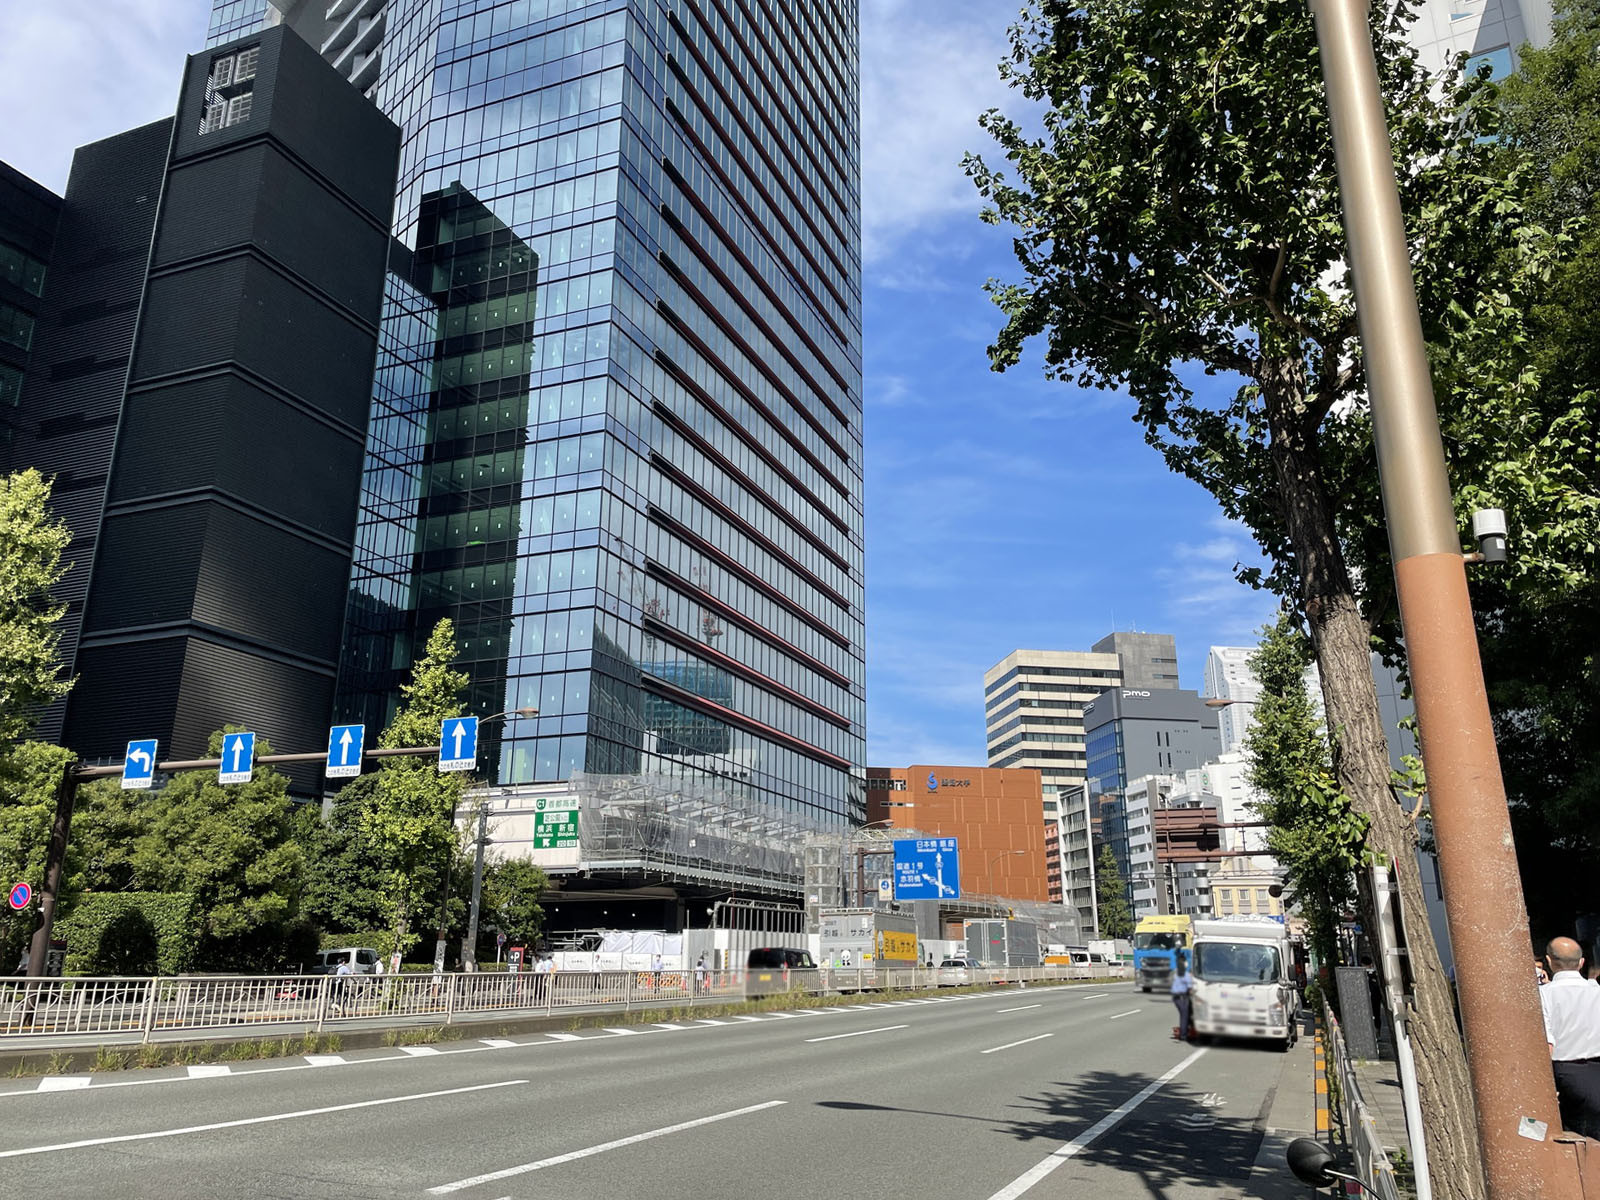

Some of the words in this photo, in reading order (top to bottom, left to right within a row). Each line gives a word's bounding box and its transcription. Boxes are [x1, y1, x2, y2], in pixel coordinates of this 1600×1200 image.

[537, 800, 545, 808] C1
[537, 824, 553, 833] 横浜
[559, 823, 575, 832] 新宿
[916, 840, 937, 849] 日本橋
[939, 839, 955, 848] 銀座
[900, 875, 921, 883] 赤羽橋
[850, 928, 873, 937] サカイ
